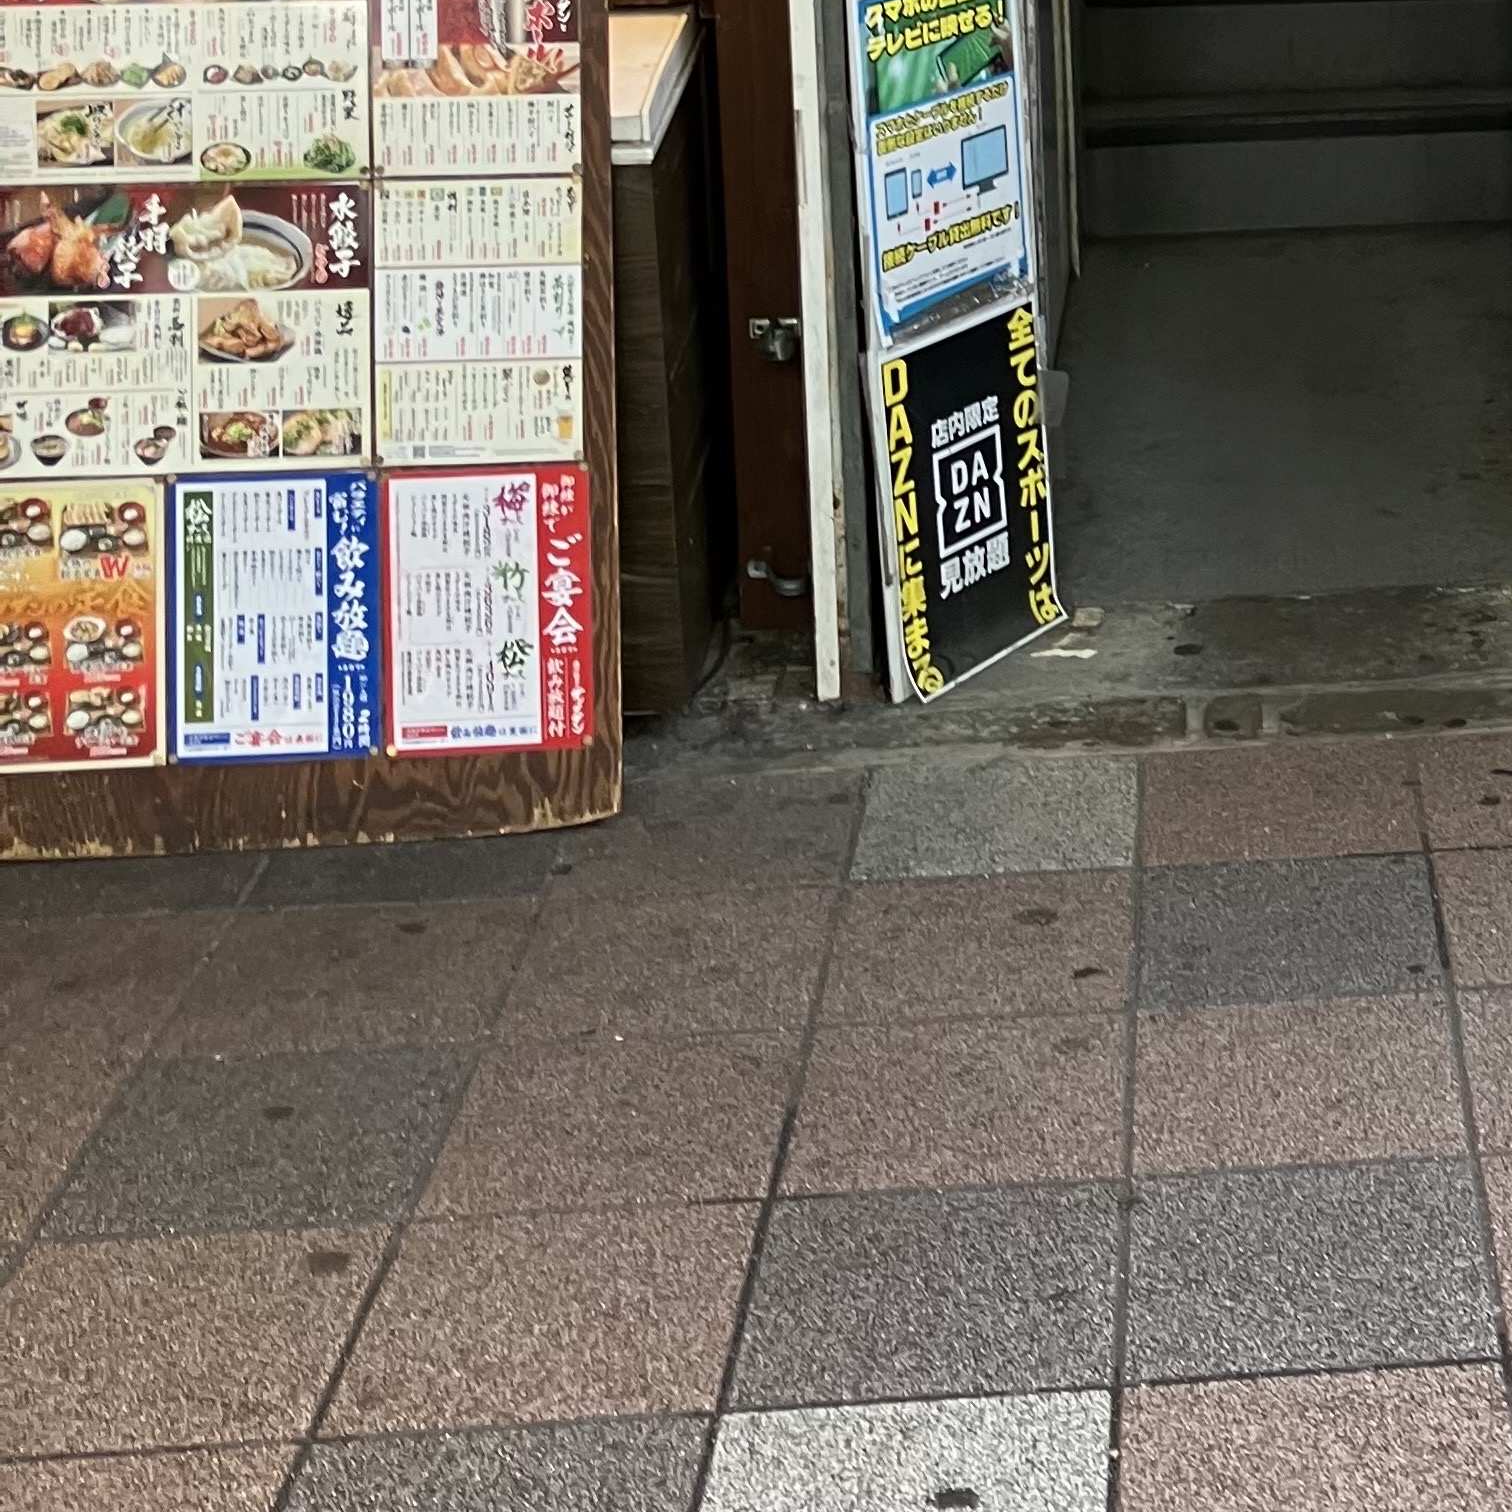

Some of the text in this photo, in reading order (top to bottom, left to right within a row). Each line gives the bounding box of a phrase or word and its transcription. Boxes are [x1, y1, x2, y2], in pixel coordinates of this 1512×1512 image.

[328, 192, 361, 279] 水餃子
[930, 394, 1000, 449] 店内限定
[1006, 306, 1061, 625] 全てのスポーツは
[883, 358, 945, 695] DAZNに集まる
[938, 531, 1011, 600] 見放題
[330, 535, 370, 662] 飲み放題
[541, 532, 584, 647] ご宴会
